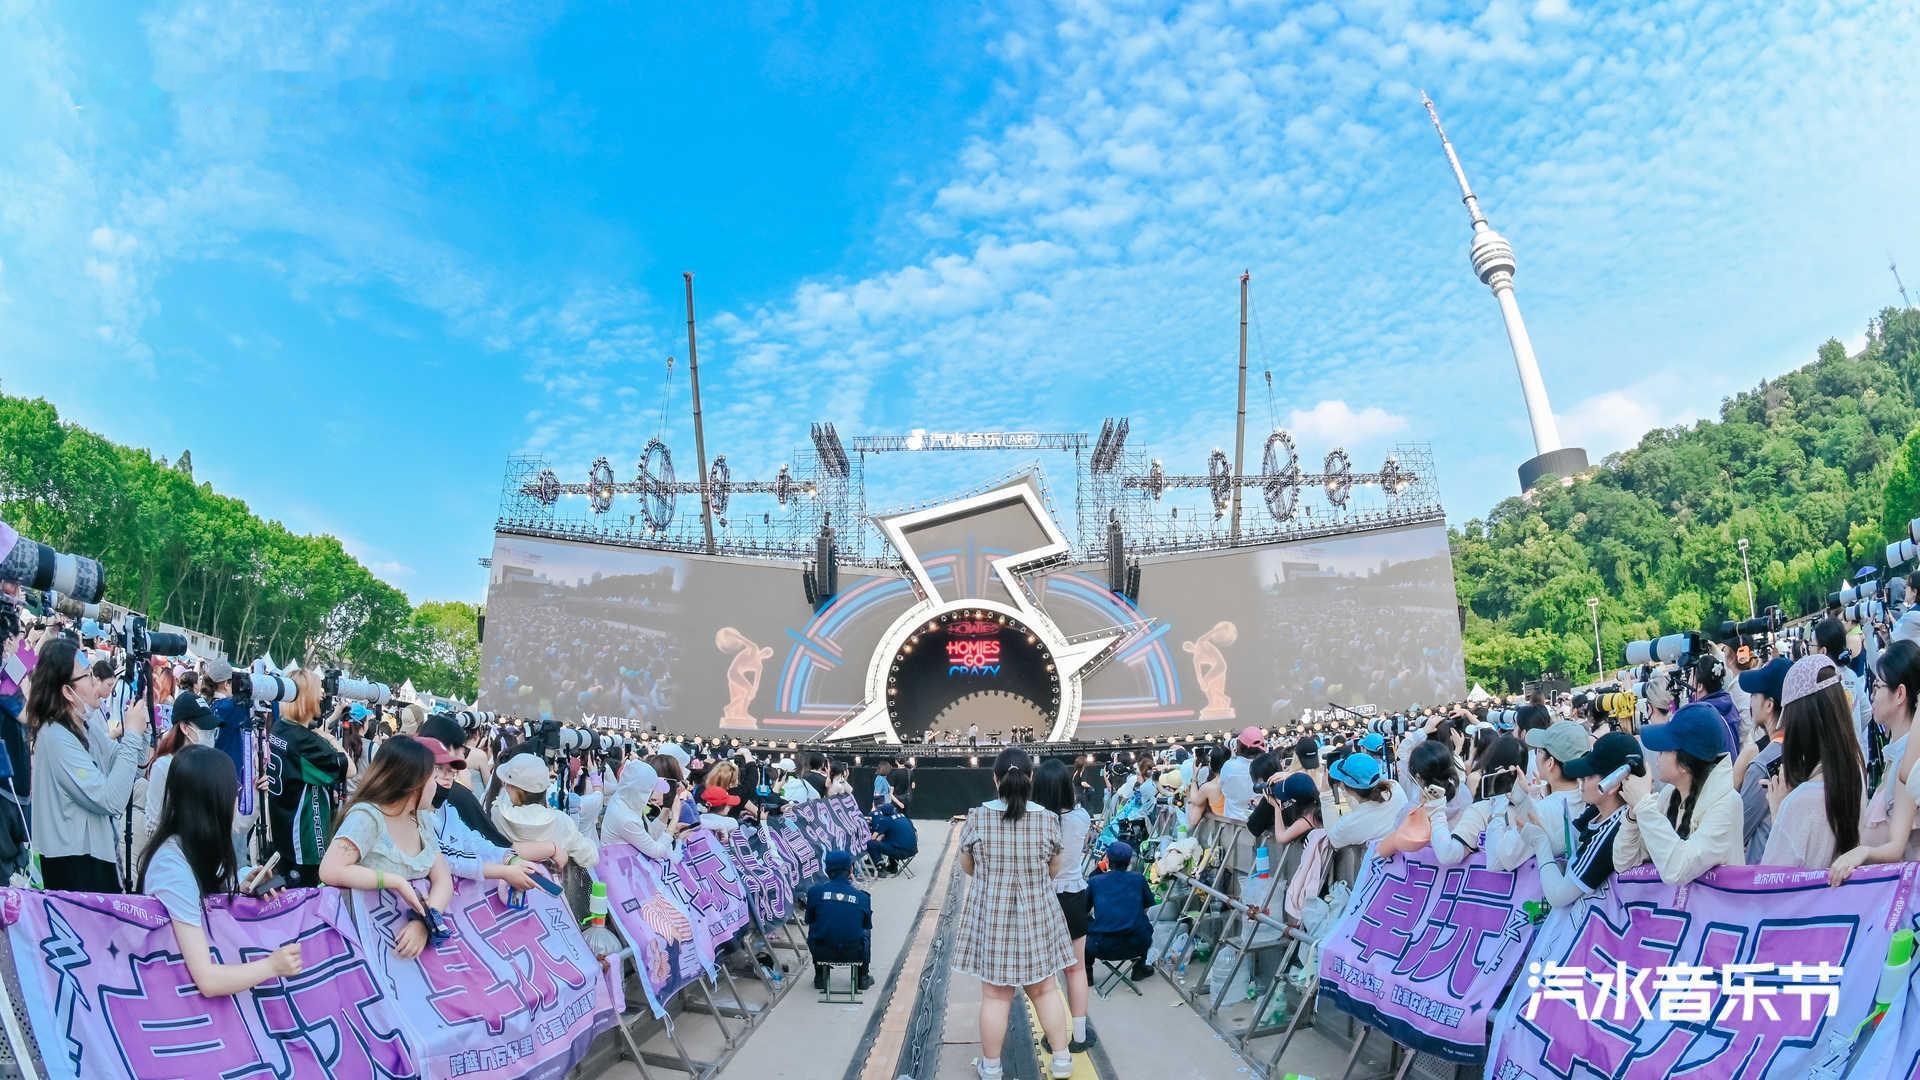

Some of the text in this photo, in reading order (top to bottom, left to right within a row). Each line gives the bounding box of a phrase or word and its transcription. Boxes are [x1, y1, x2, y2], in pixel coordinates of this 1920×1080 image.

[929, 432, 1034, 449] 汽水音乐 APP
[946, 640, 1000, 655] HOMIES
[963, 653, 986, 667] GO
[1351, 858, 1517, 1000] 卓沅
[415, 886, 586, 1037] 卓沅
